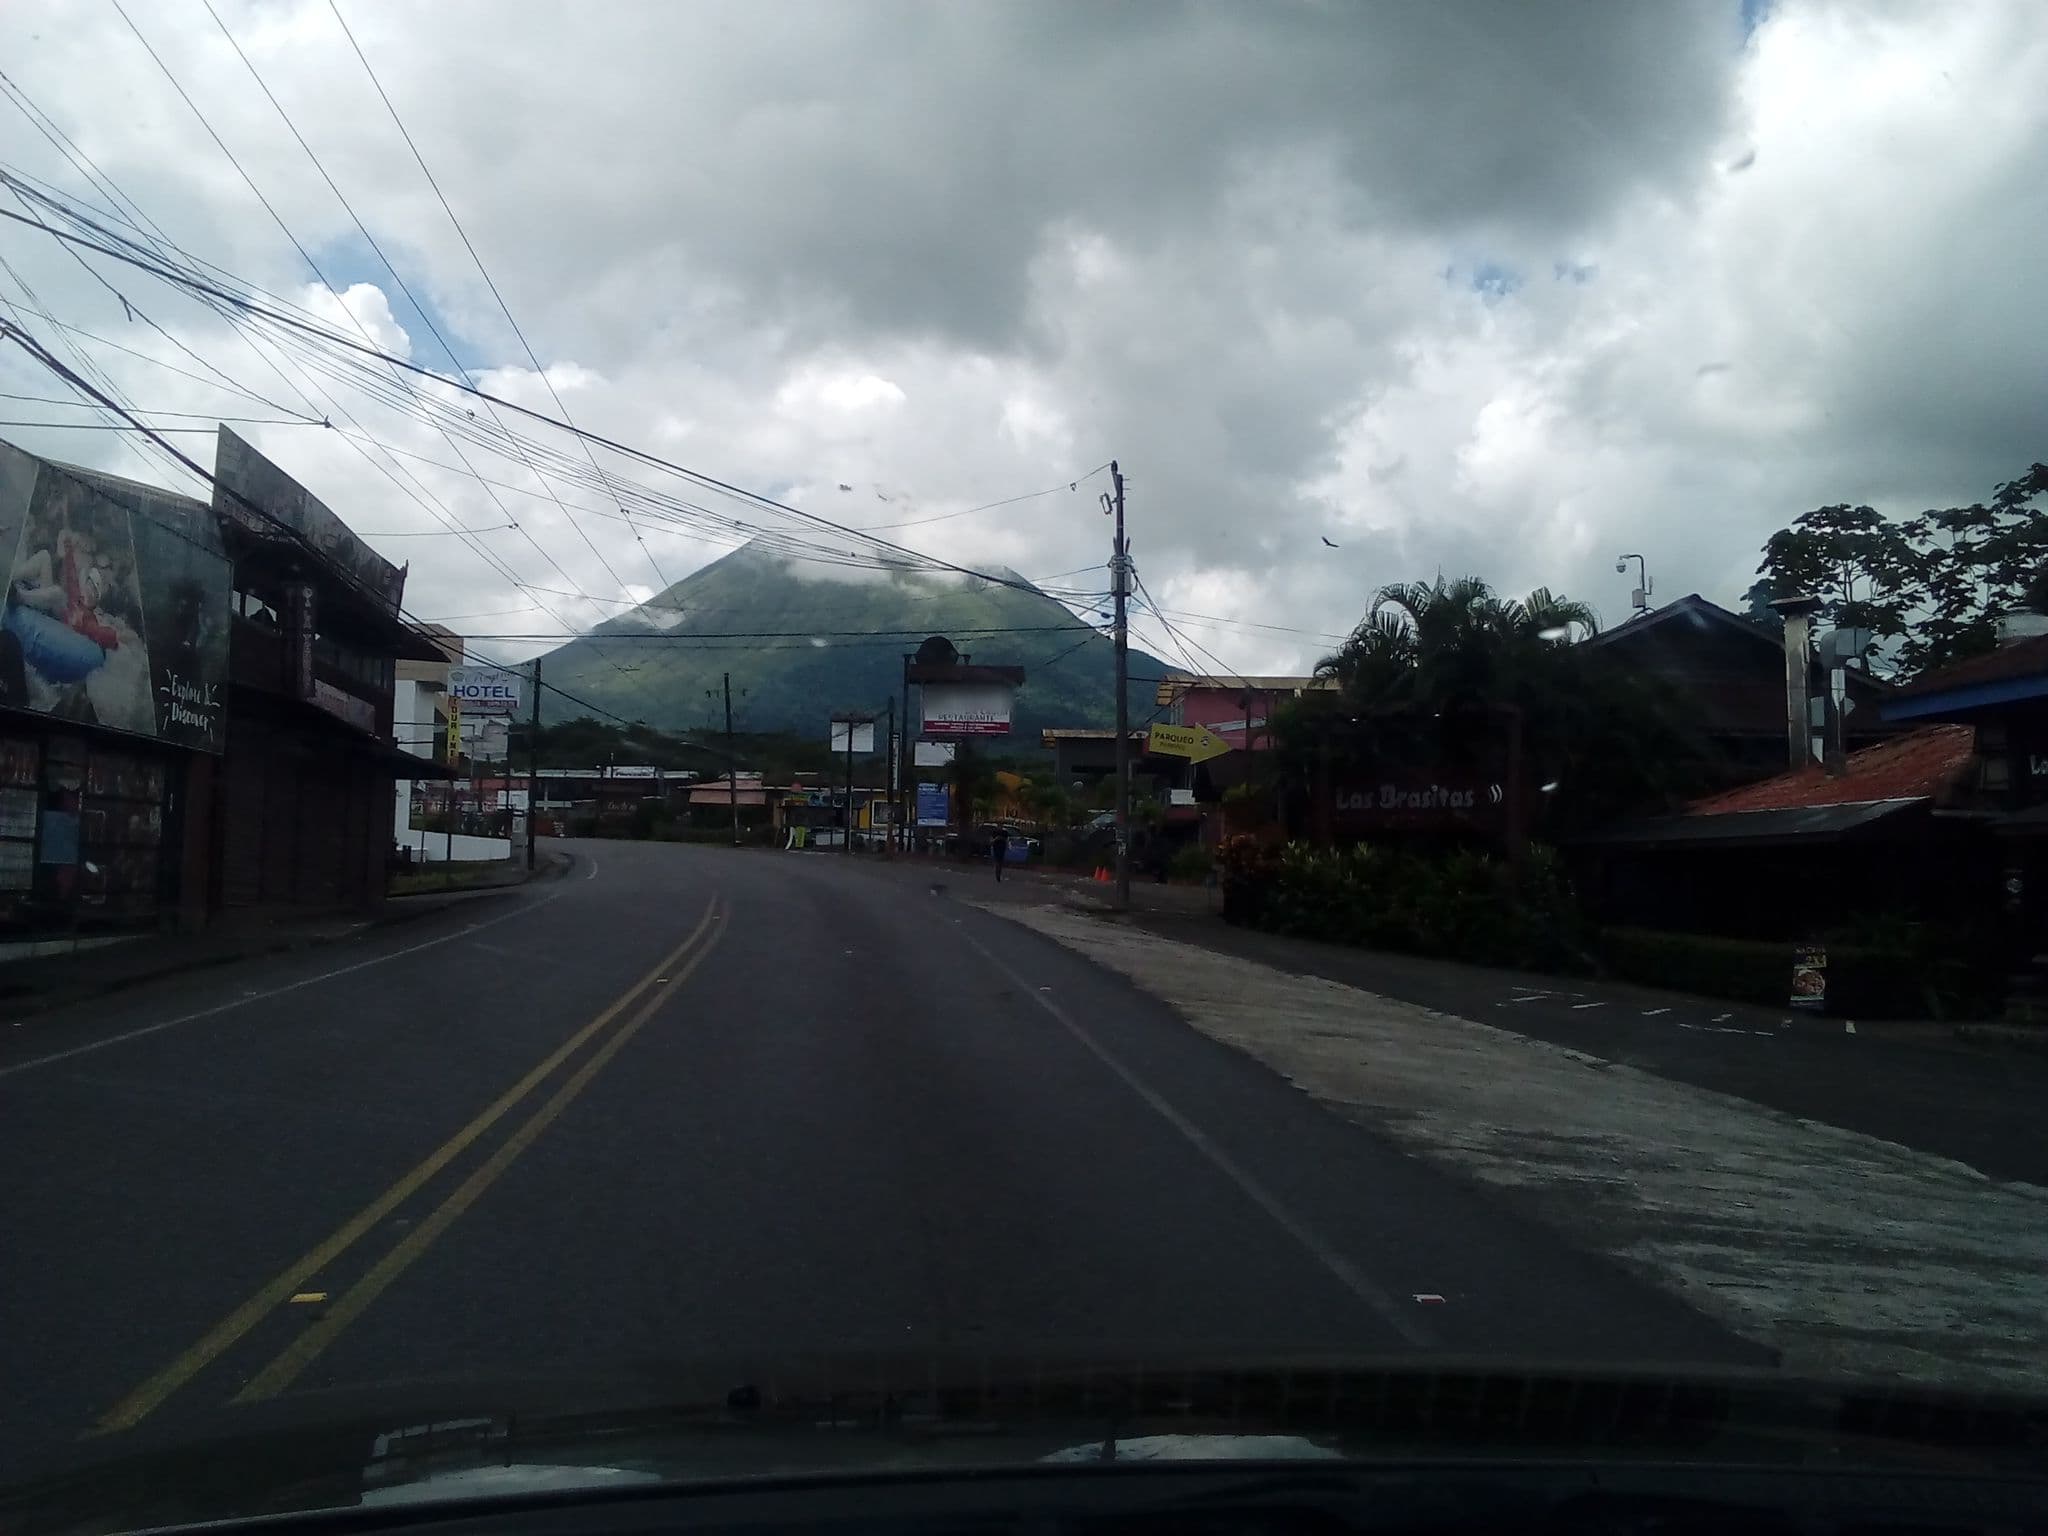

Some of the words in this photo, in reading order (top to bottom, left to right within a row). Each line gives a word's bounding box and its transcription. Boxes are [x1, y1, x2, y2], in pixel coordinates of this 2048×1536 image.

[454, 685, 515, 698] HOTEL
[1155, 732, 1194, 745] PARQUEO
[1336, 785, 1374, 808] Las
